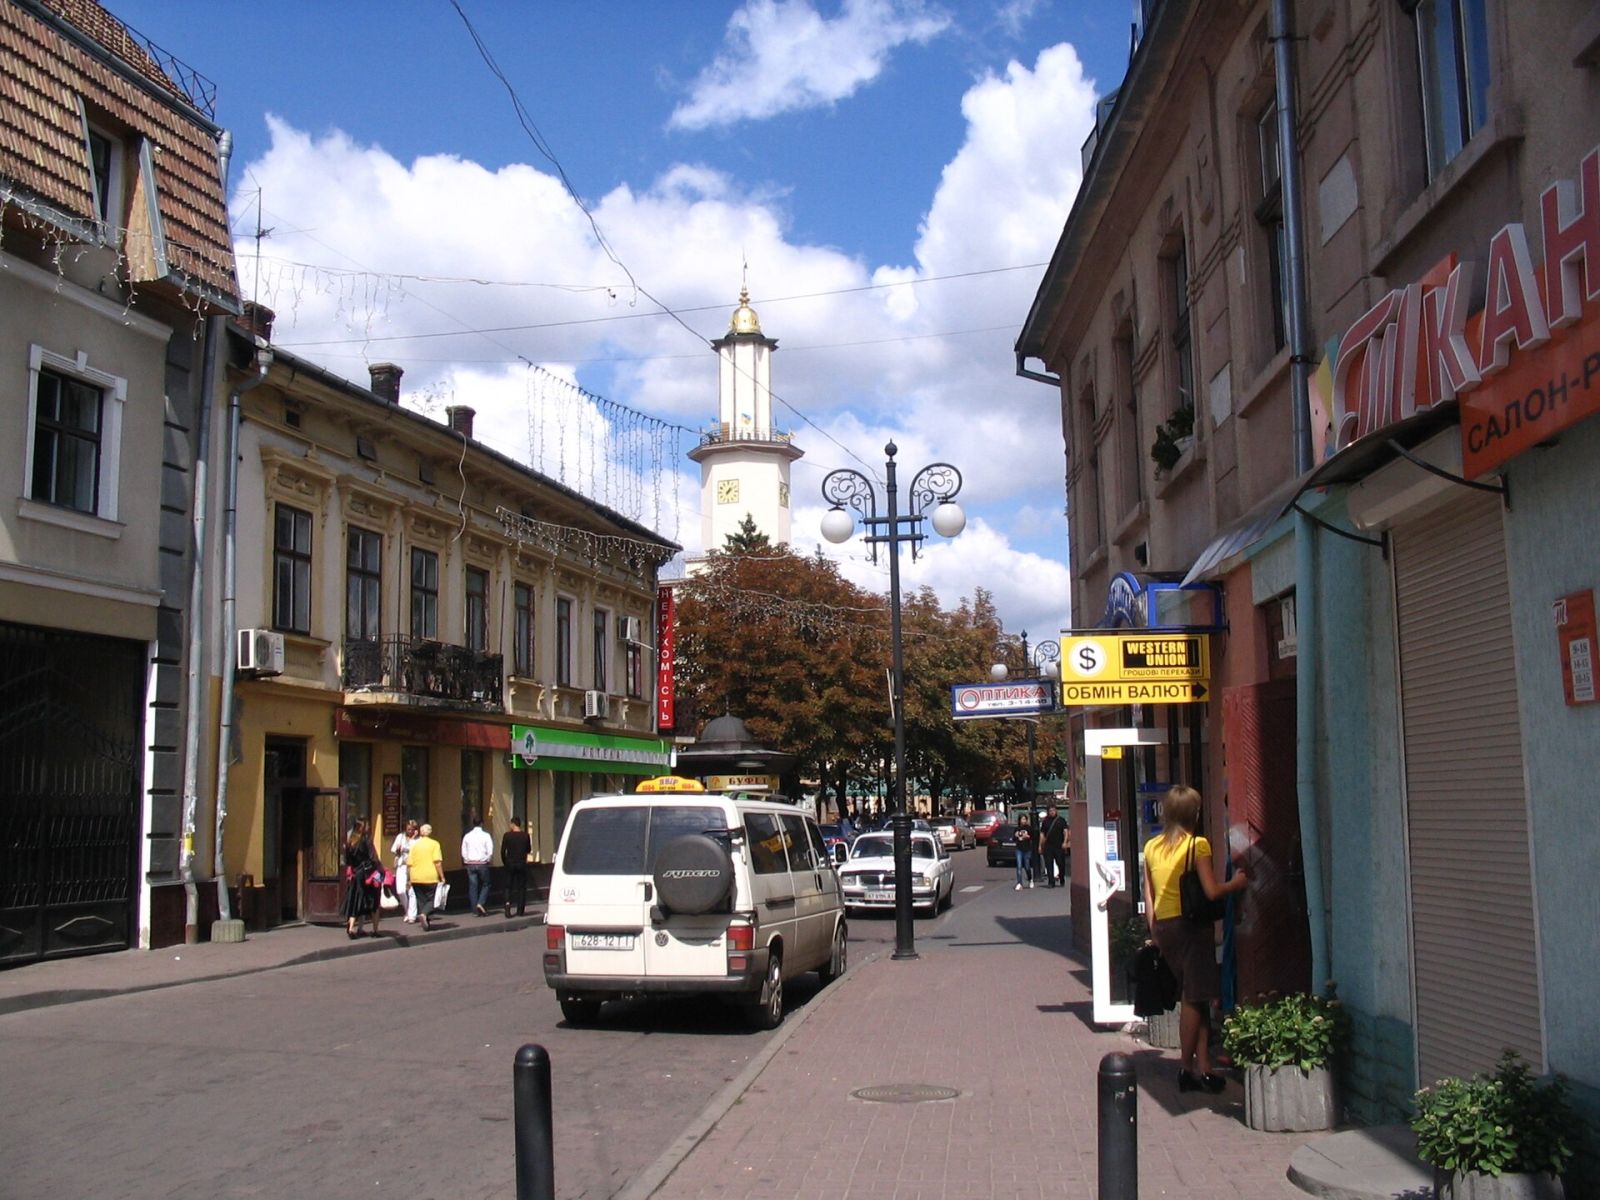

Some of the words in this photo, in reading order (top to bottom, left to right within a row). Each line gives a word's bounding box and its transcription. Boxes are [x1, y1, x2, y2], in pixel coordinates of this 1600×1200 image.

[660, 588, 670, 721] НЕРУХОМІСТЬ
[1126, 641, 1186, 655] WESTERN
[1146, 654, 1187, 666] UNION
[1066, 685, 1122, 700] ОБМІН
[1128, 684, 1190, 699] ВАЛЮТ
[563, 887, 576, 897] UA
